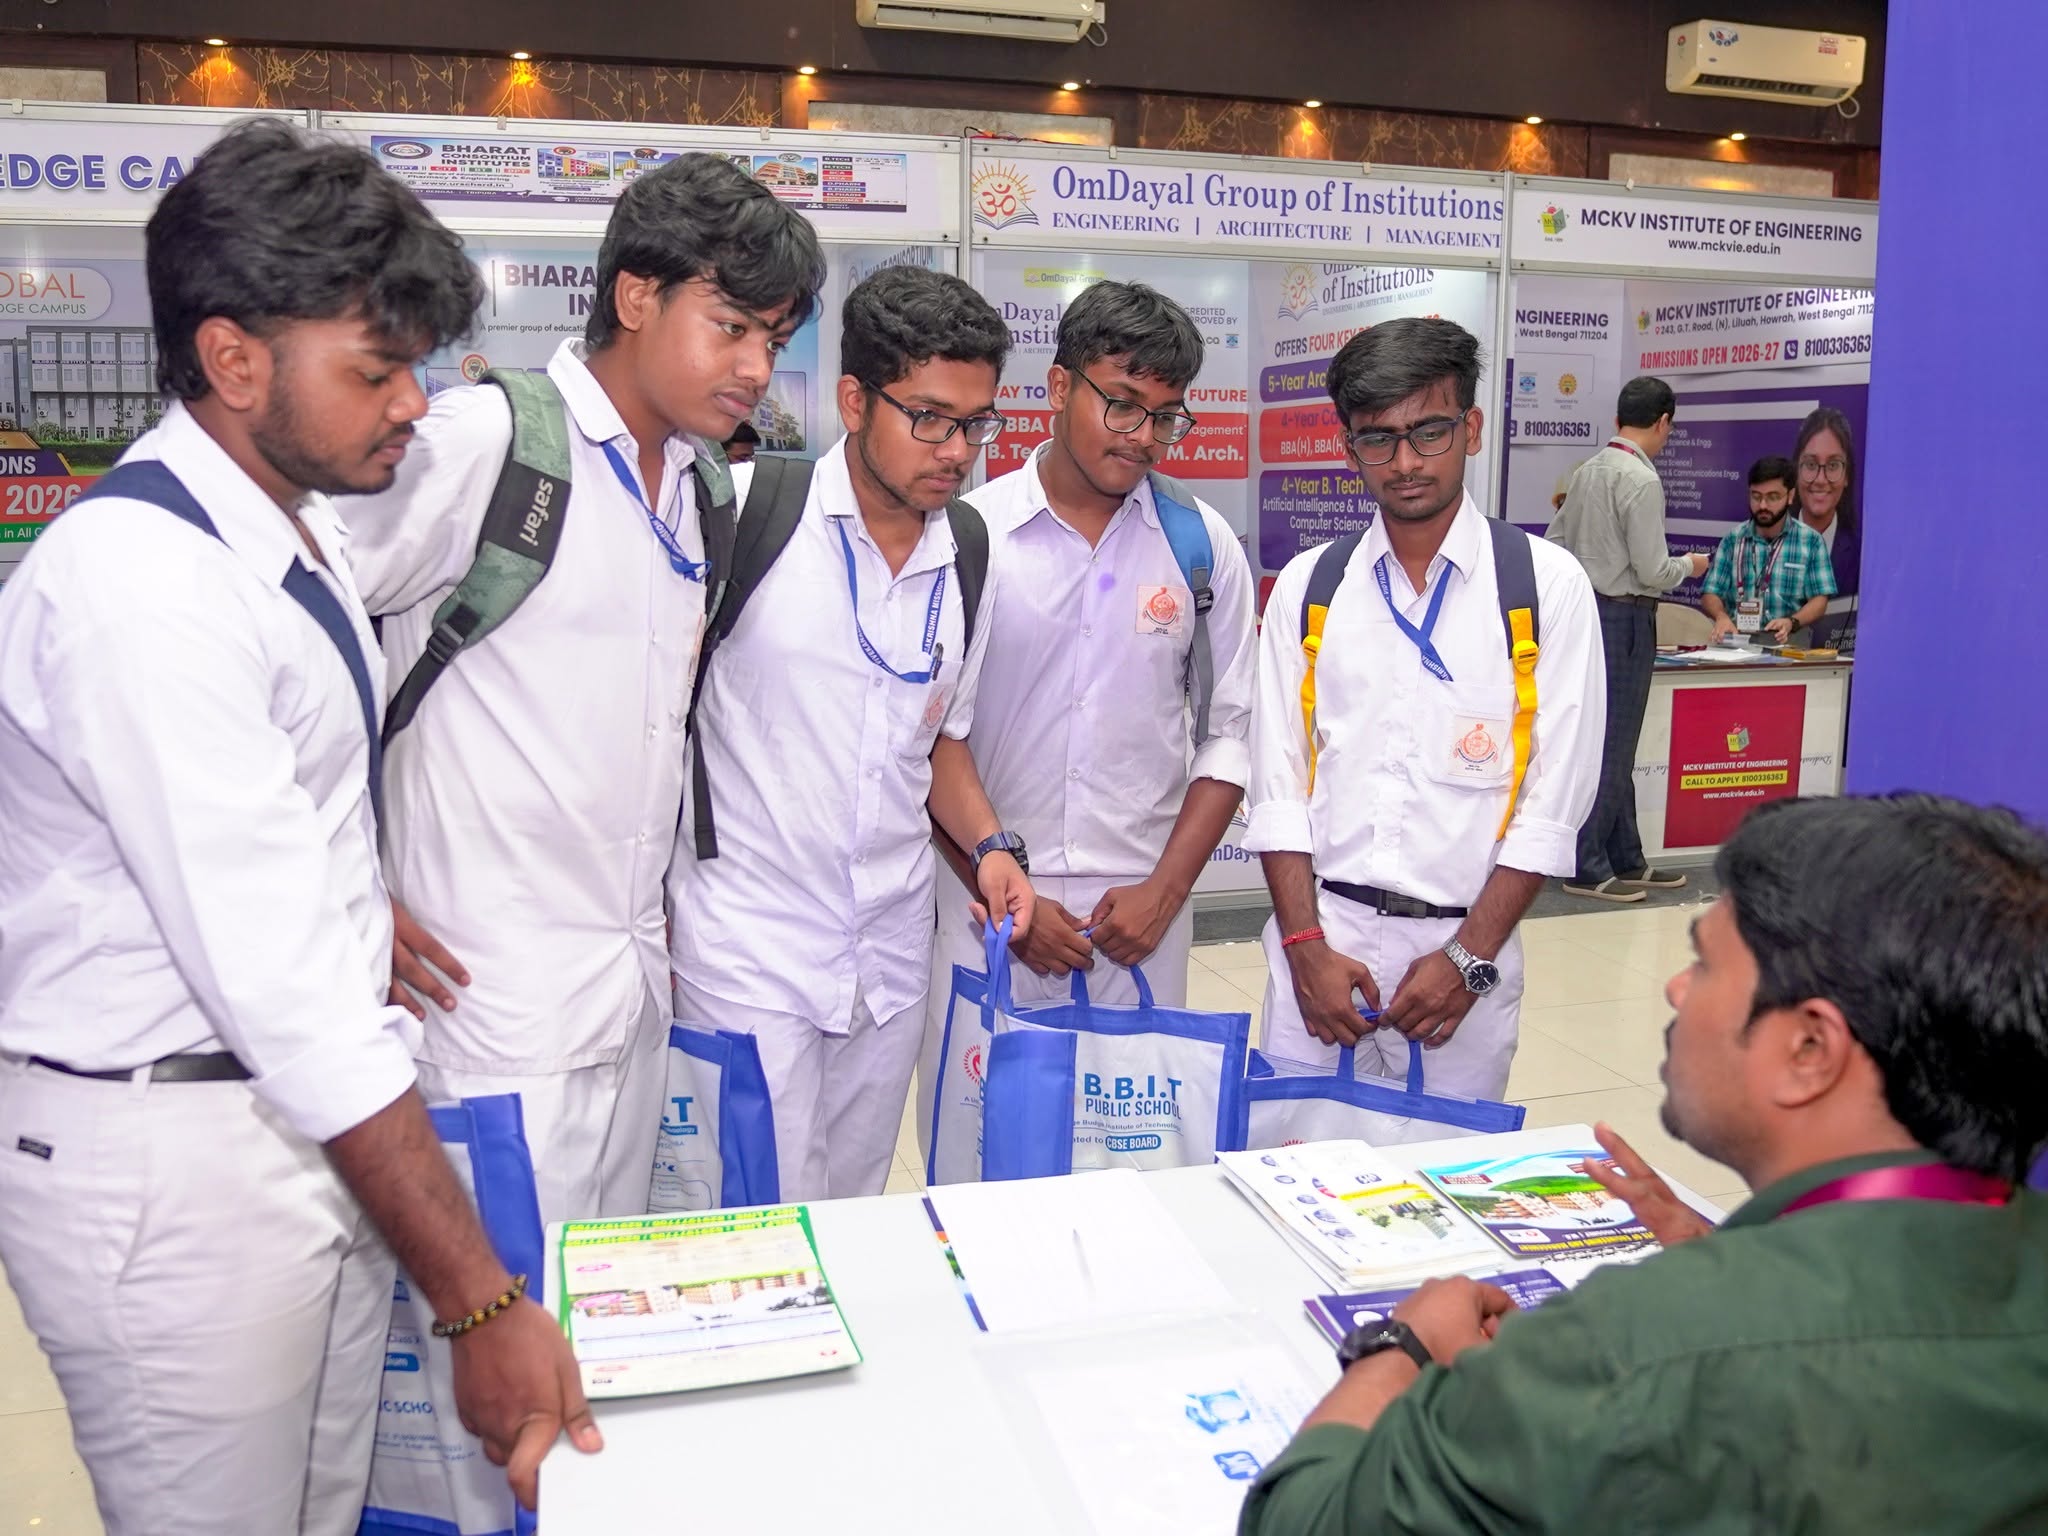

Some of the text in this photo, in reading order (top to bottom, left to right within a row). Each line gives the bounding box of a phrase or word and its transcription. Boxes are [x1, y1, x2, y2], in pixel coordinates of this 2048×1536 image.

[441, 144, 530, 155] BHARAT
[441, 153, 530, 161] CONSORTIUM
[0, 153, 106, 189] DGE
[441, 159, 530, 168] INSTITUTES
[1053, 165, 1504, 222] OmDayal Group of Institutions
[1052, 212, 1501, 249] ENGINEERING ARCHITECTURE MANAGEMENT
[1580, 208, 1862, 243] MCKV INSTITUTE OF ENGINEERING
[1668, 238, 1781, 255] www.mckvie.edu.in
[1322, 266, 1434, 304] of Institutions
[29, 303, 88, 315] CAMPUS
[1655, 303, 1694, 322] MCKV
[1695, 296, 1762, 318] INSTITUTE
[1764, 293, 1783, 310] OF
[1798, 309, 1821, 322] West
[1823, 306, 1855, 321] Bengal
[1516, 309, 1609, 328] NGINEERING
[487, 324, 518, 333] premier
[520, 324, 543, 334] group
[544, 323, 552, 332] of
[1519, 328, 1608, 341] West Bengal 711204
[1274, 337, 1308, 359] OFFERS
[1308, 332, 1335, 353] FOUR
[1640, 334, 1872, 370] ADMISSIONS OPEN 2026-27 8100336363
[1268, 372, 1305, 394] 5-Year
[993, 385, 1047, 399] AY TO
[1189, 389, 1248, 403] FUTURE
[1005, 416, 1045, 433] BBA
[1524, 420, 1591, 438] 8100336363
[1166, 445, 1244, 462] M. Arch.
[1281, 476, 1364, 495] 4-Year B. Tech
[519, 477, 554, 547] safari
[1262, 497, 1294, 512] Artificial
[1295, 498, 1346, 516] Intelligence
[1346, 500, 1354, 512] &
[4, 527, 32, 539] in All
[1289, 515, 1334, 535] Computer
[1682, 759, 1788, 771] MCKV INSTITUTE OF ENGINEERING
[1685, 777, 1704, 787] CALL
[1705, 776, 1716, 786] TO
[1716, 775, 1740, 785] APPLY
[1702, 788, 1765, 800] www.mckvie.edu.in
[1084, 1072, 1182, 1102] B.B.I.T
[1085, 1098, 1182, 1120] PUBLIC SCHOOL
[1094, 1135, 1104, 1144] to
[1106, 1138, 1128, 1150] CBSE
[1129, 1136, 1159, 1150] BOARD
